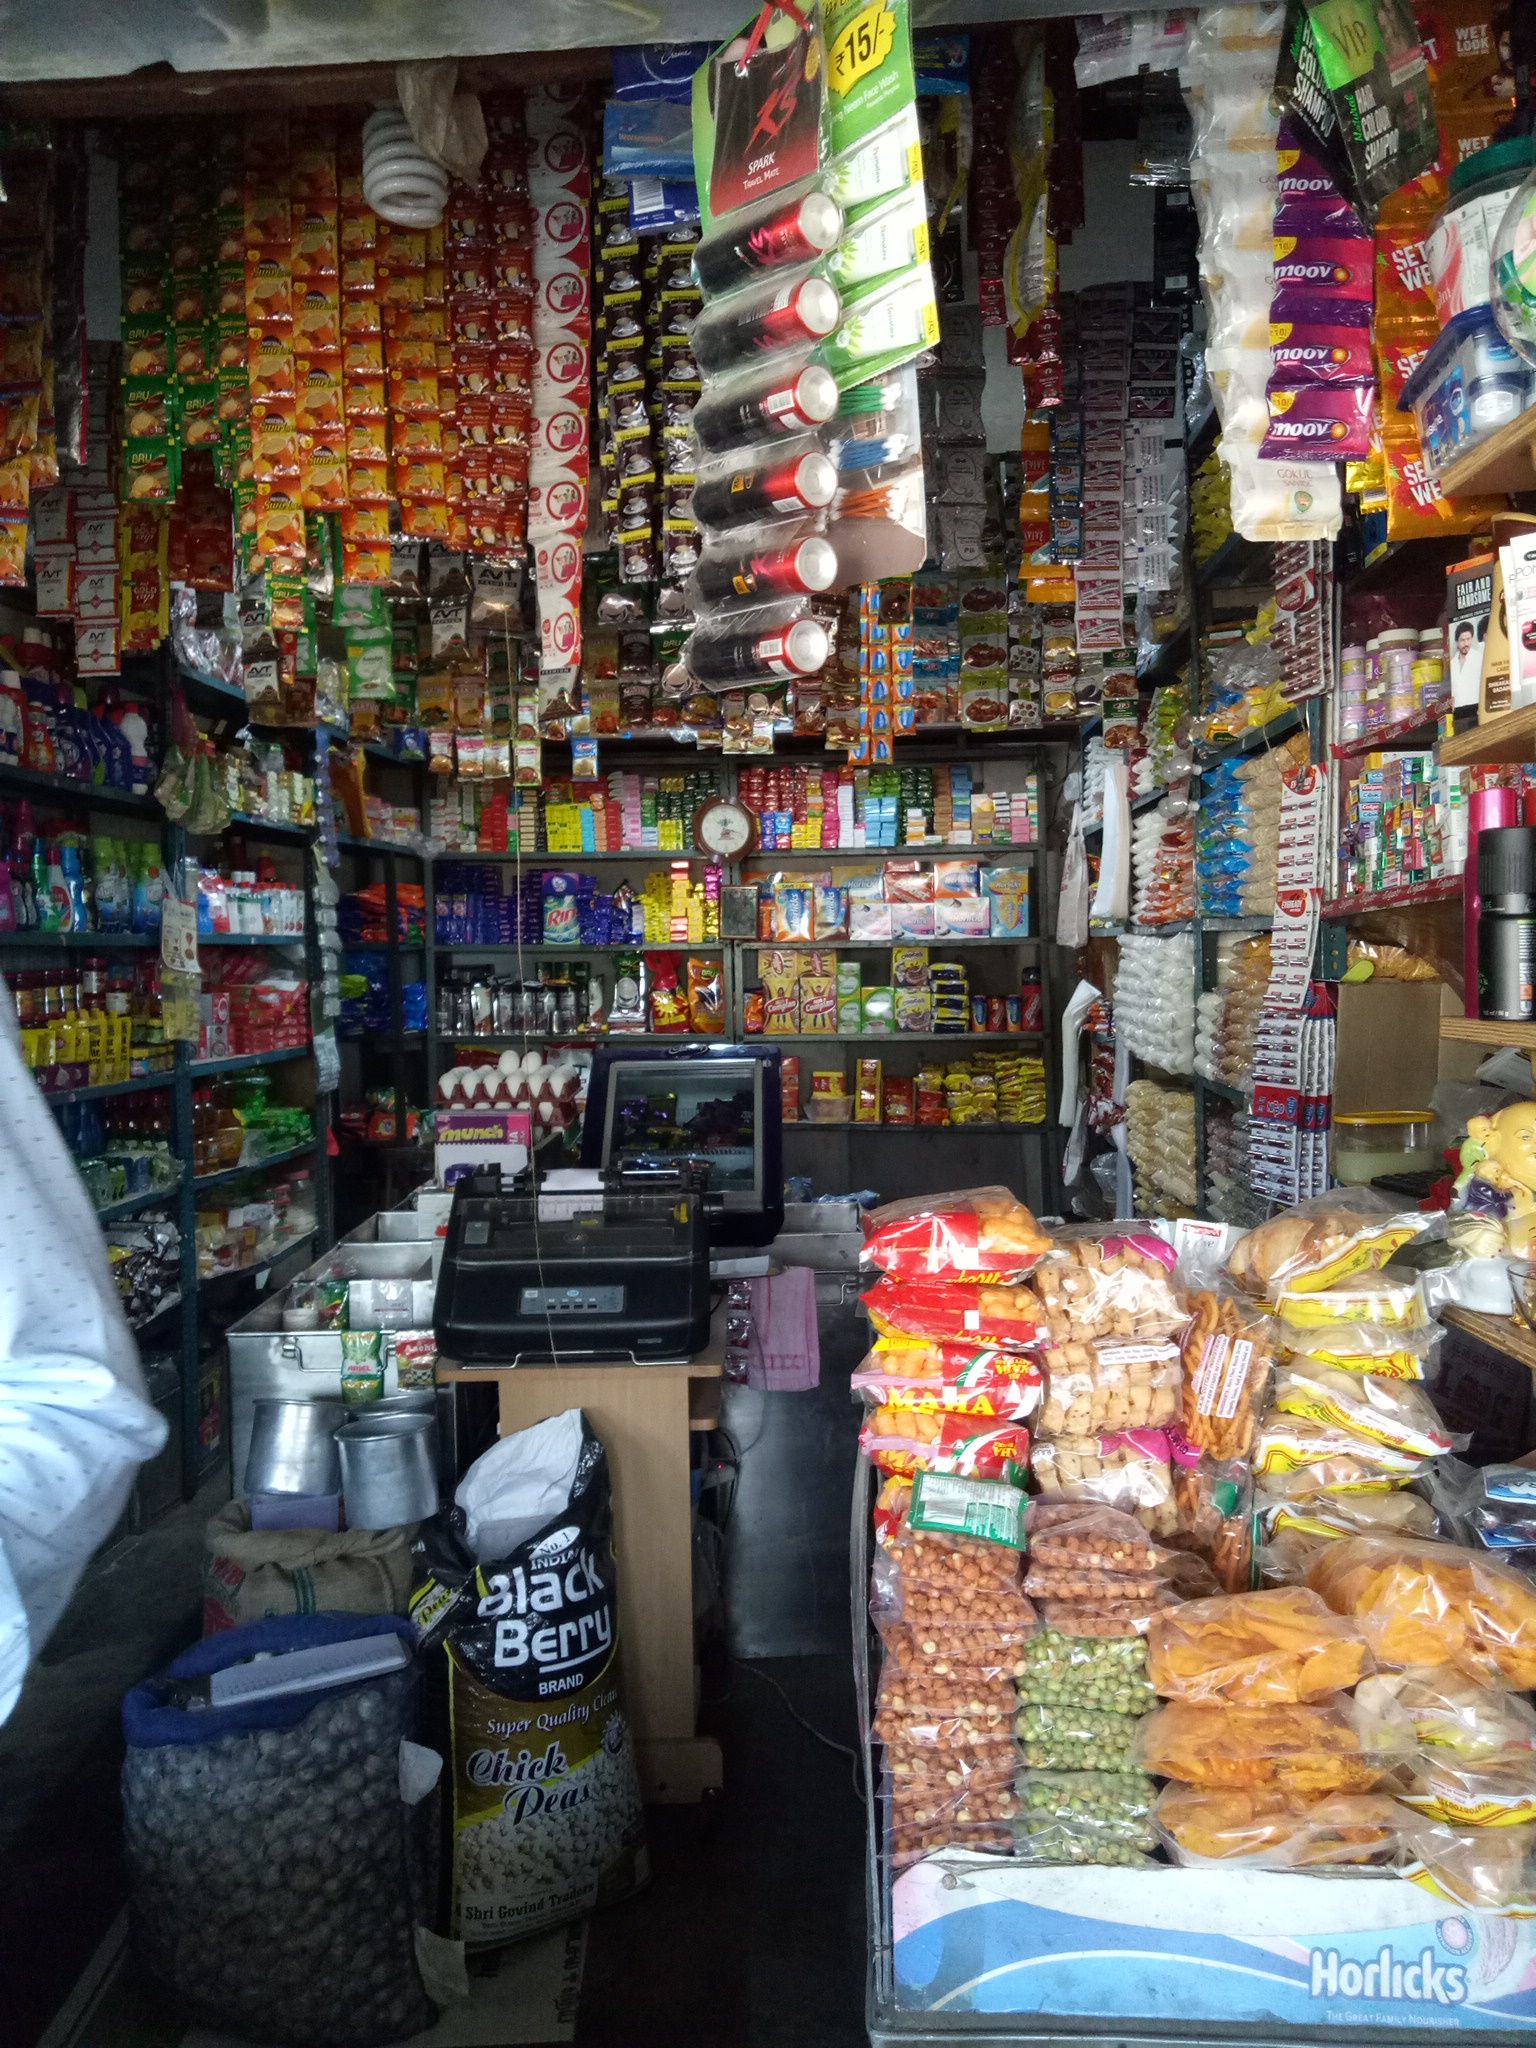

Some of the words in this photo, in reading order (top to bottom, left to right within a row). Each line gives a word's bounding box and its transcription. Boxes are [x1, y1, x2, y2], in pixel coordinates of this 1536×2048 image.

[1456, 24, 1488, 40] WET
[1457, 37, 1490, 52] LOOK
[863, 84, 881, 103] Face
[880, 70, 900, 92] Wash
[1458, 135, 1490, 151] WET
[747, 151, 776, 176] SPARK
[1279, 177, 1333, 192] moov
[1275, 264, 1331, 279] moov
[1399, 263, 1432, 292] WE
[1271, 348, 1327, 362] moov
[128, 392, 150, 402] BRU
[185, 399, 205, 409] BRU
[1272, 422, 1328, 437] moov
[131, 453, 153, 464] BRU
[1403, 458, 1426, 483] SE
[1410, 480, 1442, 508] WE
[43, 570, 62, 580] AVT
[89, 577, 105, 587] AVT
[480, 568, 514, 581] AVT
[273, 589, 290, 598] BRU
[1456, 580, 1474, 597] FAIR
[1474, 575, 1491, 592] AND
[244, 612, 265, 622] AVT
[433, 608, 463, 619] AVT
[89, 631, 106, 641] AVT
[662, 639, 681, 648] BRU
[249, 665, 272, 674] AVT
[547, 909, 577, 927] Rin
[439, 1125, 505, 1142] munch
[539, 1542, 562, 1555] No.
[477, 1547, 605, 1618] Black
[494, 1604, 612, 1668] Berry
[538, 1673, 584, 1695] BRAND
[487, 1719, 532, 1740] Super
[536, 1703, 591, 1730] Quality
[466, 1741, 569, 1786] Chick
[504, 1784, 592, 1826] Peas
[465, 1904, 494, 1920] Shri
[499, 1900, 545, 1919] Govind
[548, 1883, 595, 1906] Traders
[1311, 1946, 1467, 2004] Horlicks
[1326, 2010, 1343, 2021] THE
[1345, 2011, 1373, 2022] GREAT
[1408, 2014, 1460, 2027] NOURISHER
